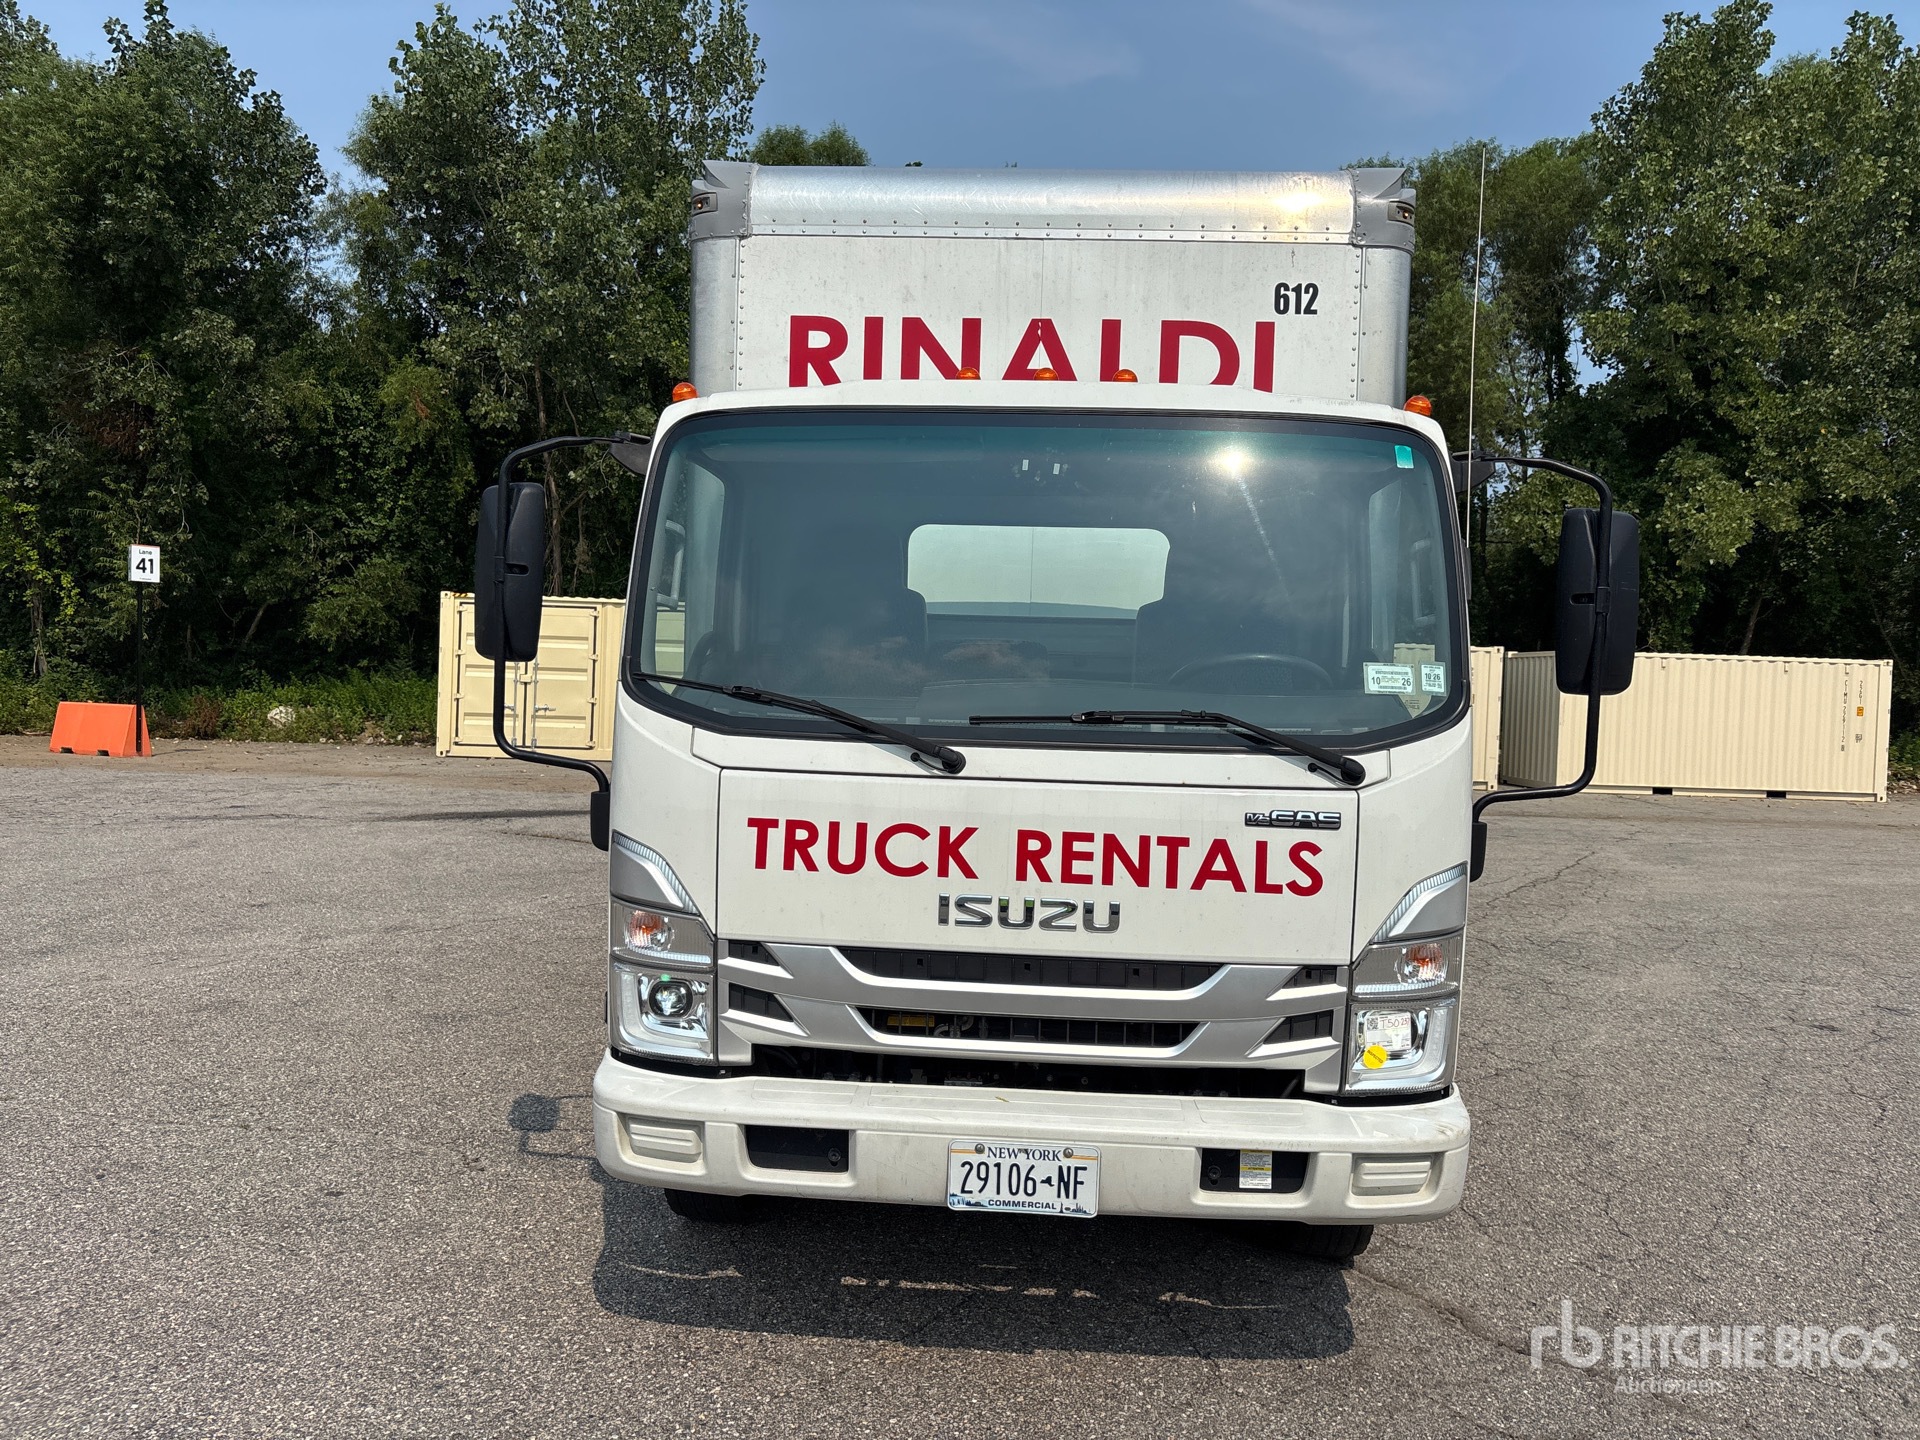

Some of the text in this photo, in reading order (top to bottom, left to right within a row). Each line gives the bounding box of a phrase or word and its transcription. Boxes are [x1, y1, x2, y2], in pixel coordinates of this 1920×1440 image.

[1273, 282, 1319, 316] 612
[788, 315, 1277, 393] RINALDI
[139, 548, 152, 556] Lane
[135, 558, 153, 574] 41
[1371, 676, 1381, 685] 10
[1401, 677, 1412, 687] 26
[747, 817, 1324, 897] TRUCK RENTALS
[937, 892, 1121, 934] ISUZU
[987, 1146, 1062, 1162] NEW YORK
[960, 1160, 1088, 1200] 29106 NF
[987, 1199, 1057, 1210] COMMERCIAL
